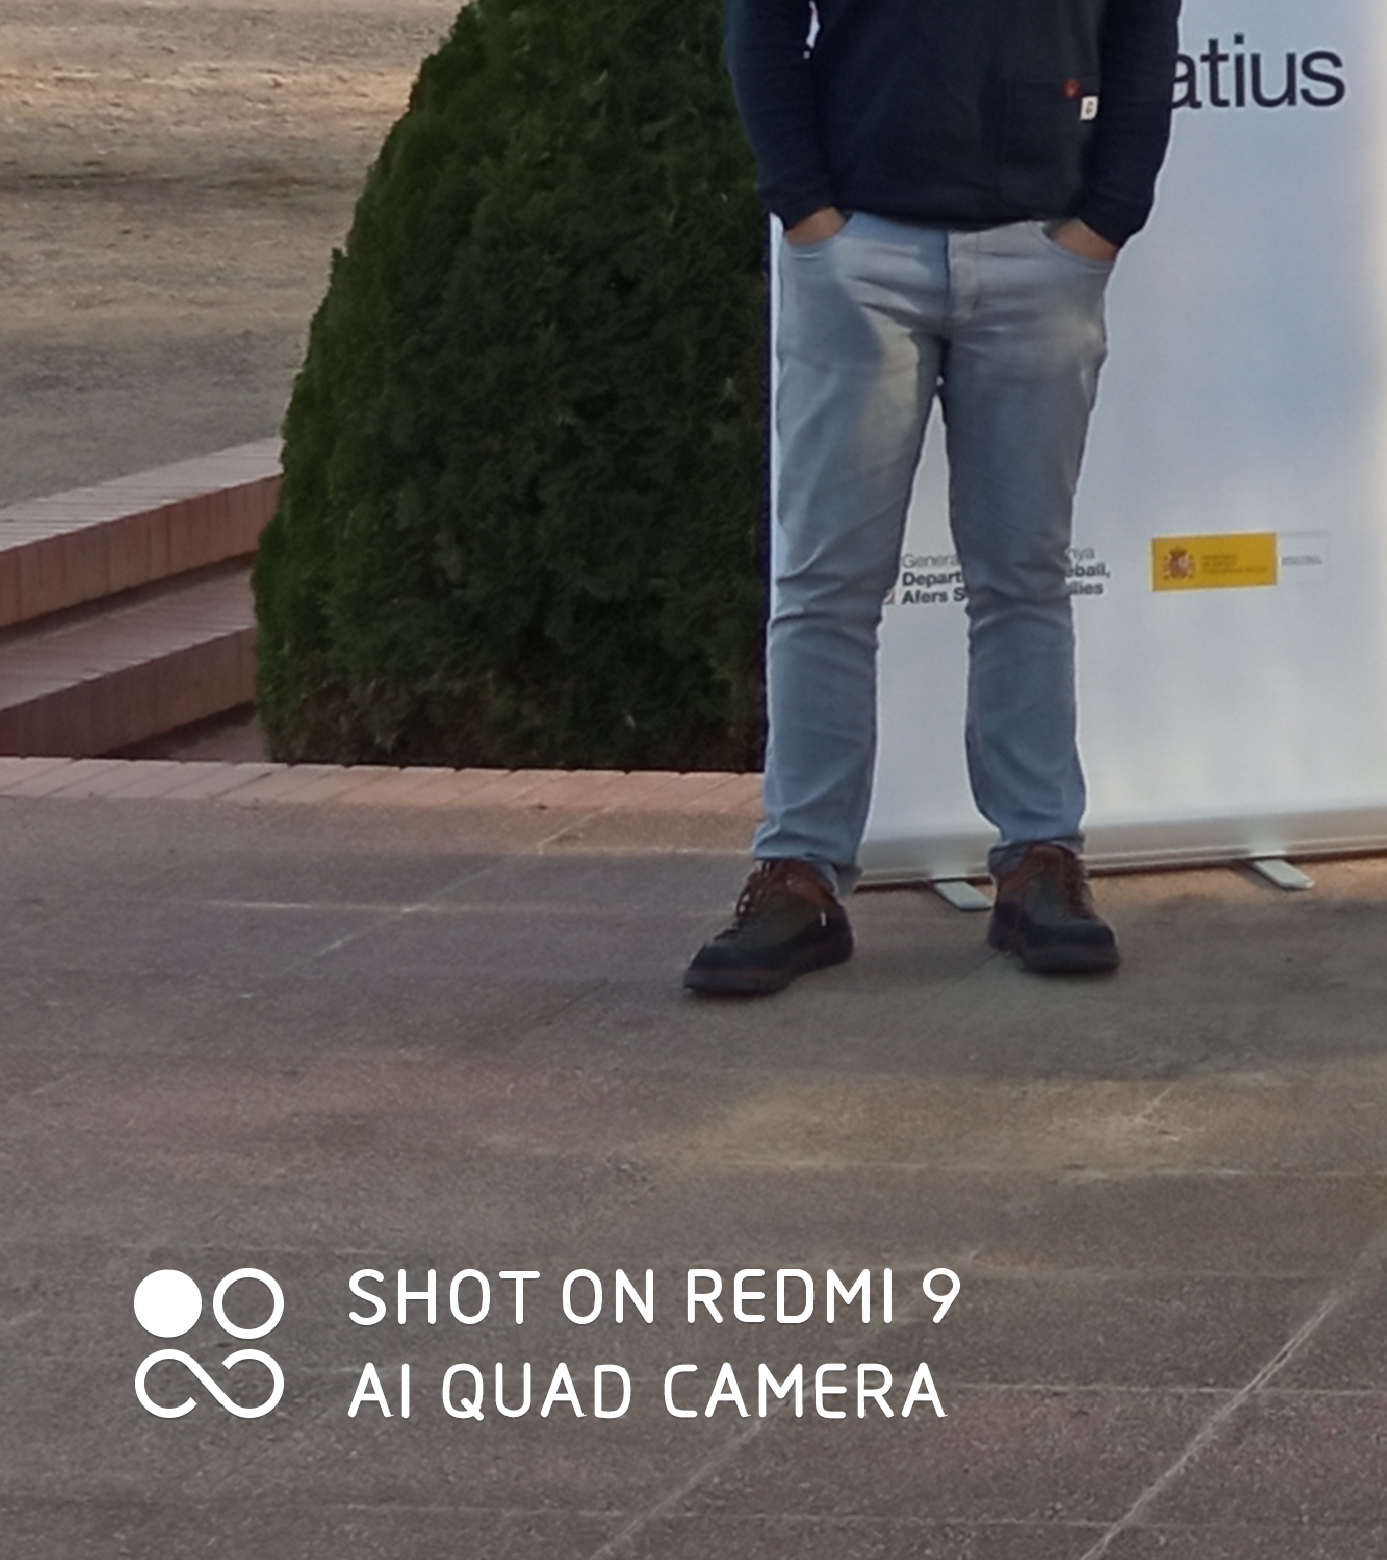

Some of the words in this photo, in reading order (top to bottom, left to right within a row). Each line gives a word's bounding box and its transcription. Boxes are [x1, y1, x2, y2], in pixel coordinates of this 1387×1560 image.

[1171, 32, 1346, 110] atius
[902, 553, 960, 569] Genera
[902, 571, 962, 588] Depart
